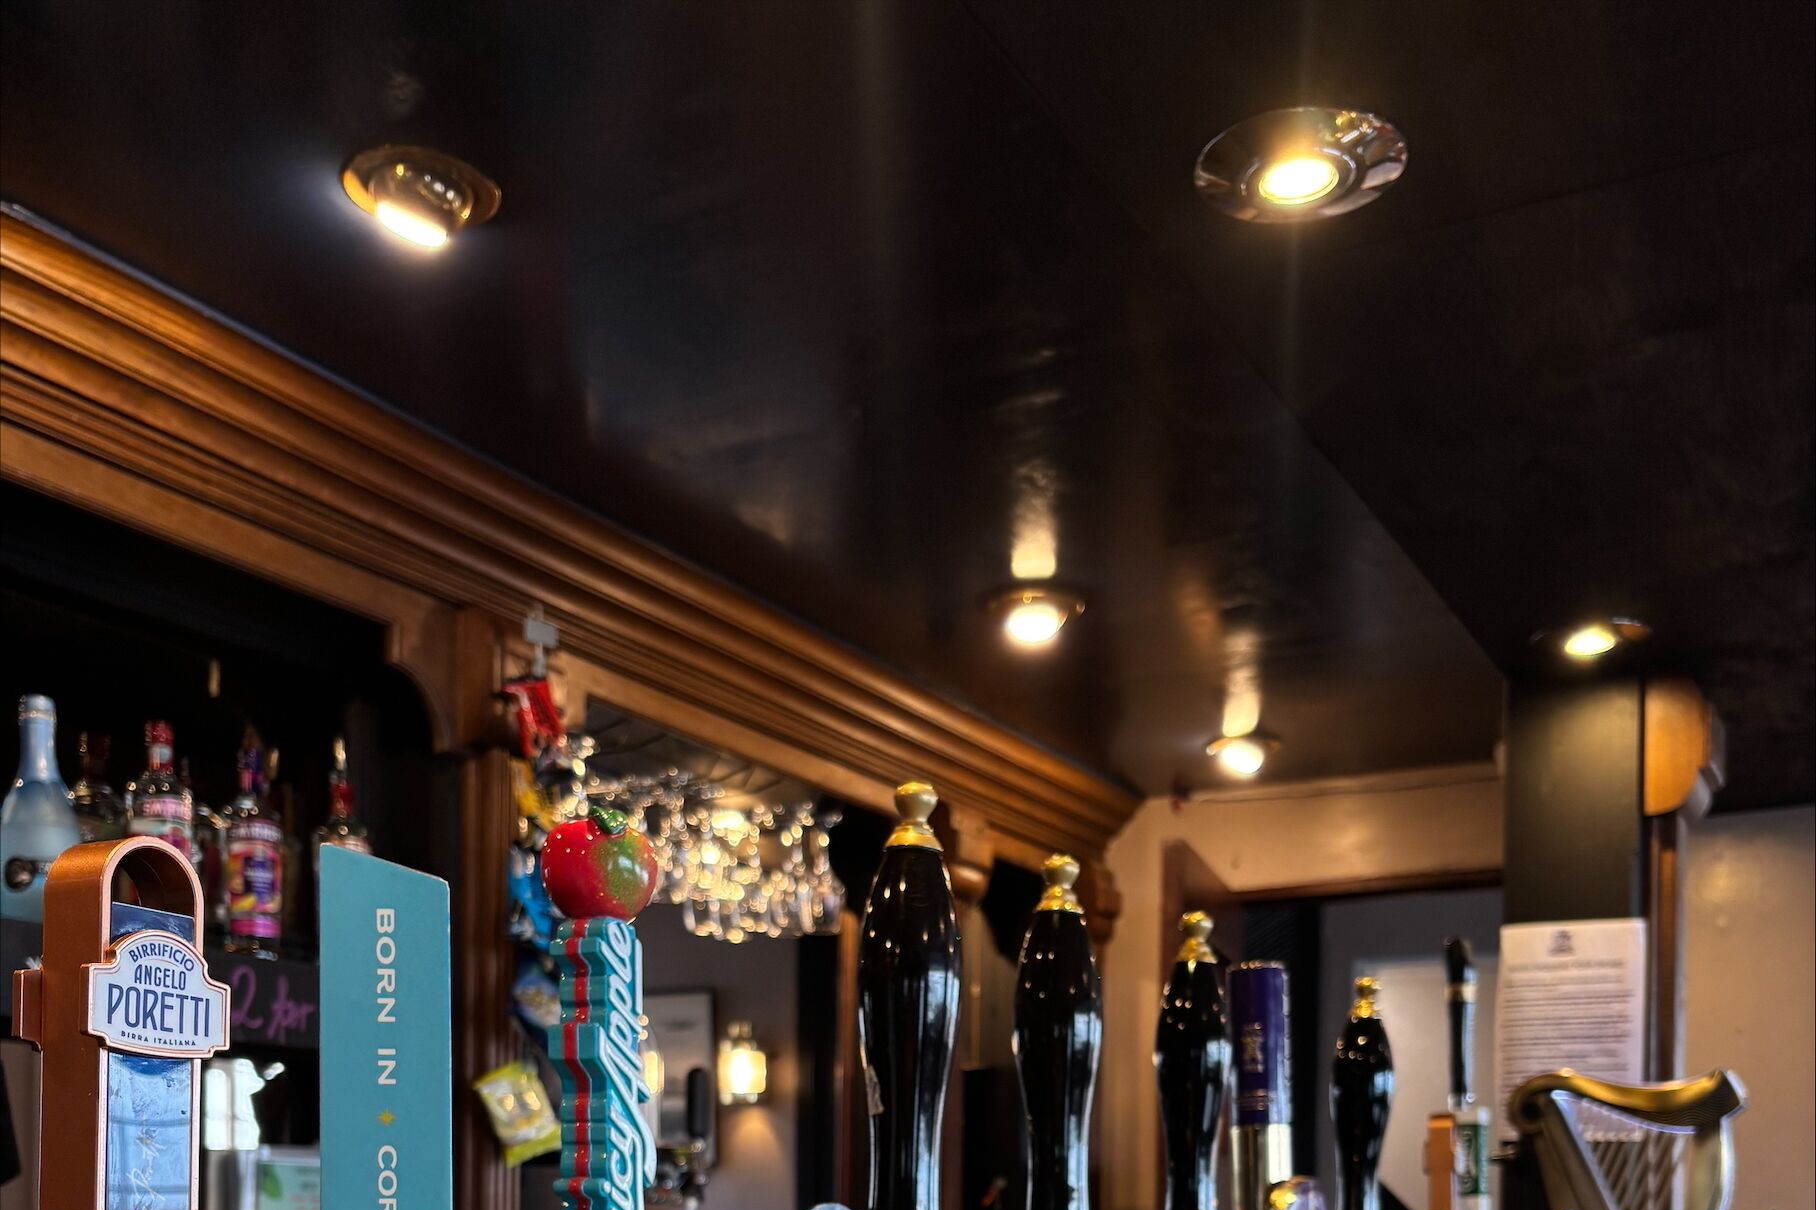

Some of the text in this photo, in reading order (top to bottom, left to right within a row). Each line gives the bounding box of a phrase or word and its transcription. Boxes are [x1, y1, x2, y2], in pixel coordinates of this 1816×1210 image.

[128, 943, 195, 972] BIRRIFICIO
[375, 907, 397, 1023] BORN
[134, 964, 187, 991] ANGELO
[107, 983, 210, 1038] PORETTI
[121, 1030, 196, 1046] BIRRA ITALIANA
[600, 921, 657, 1188] Apple
[377, 1048, 397, 1085] IN
